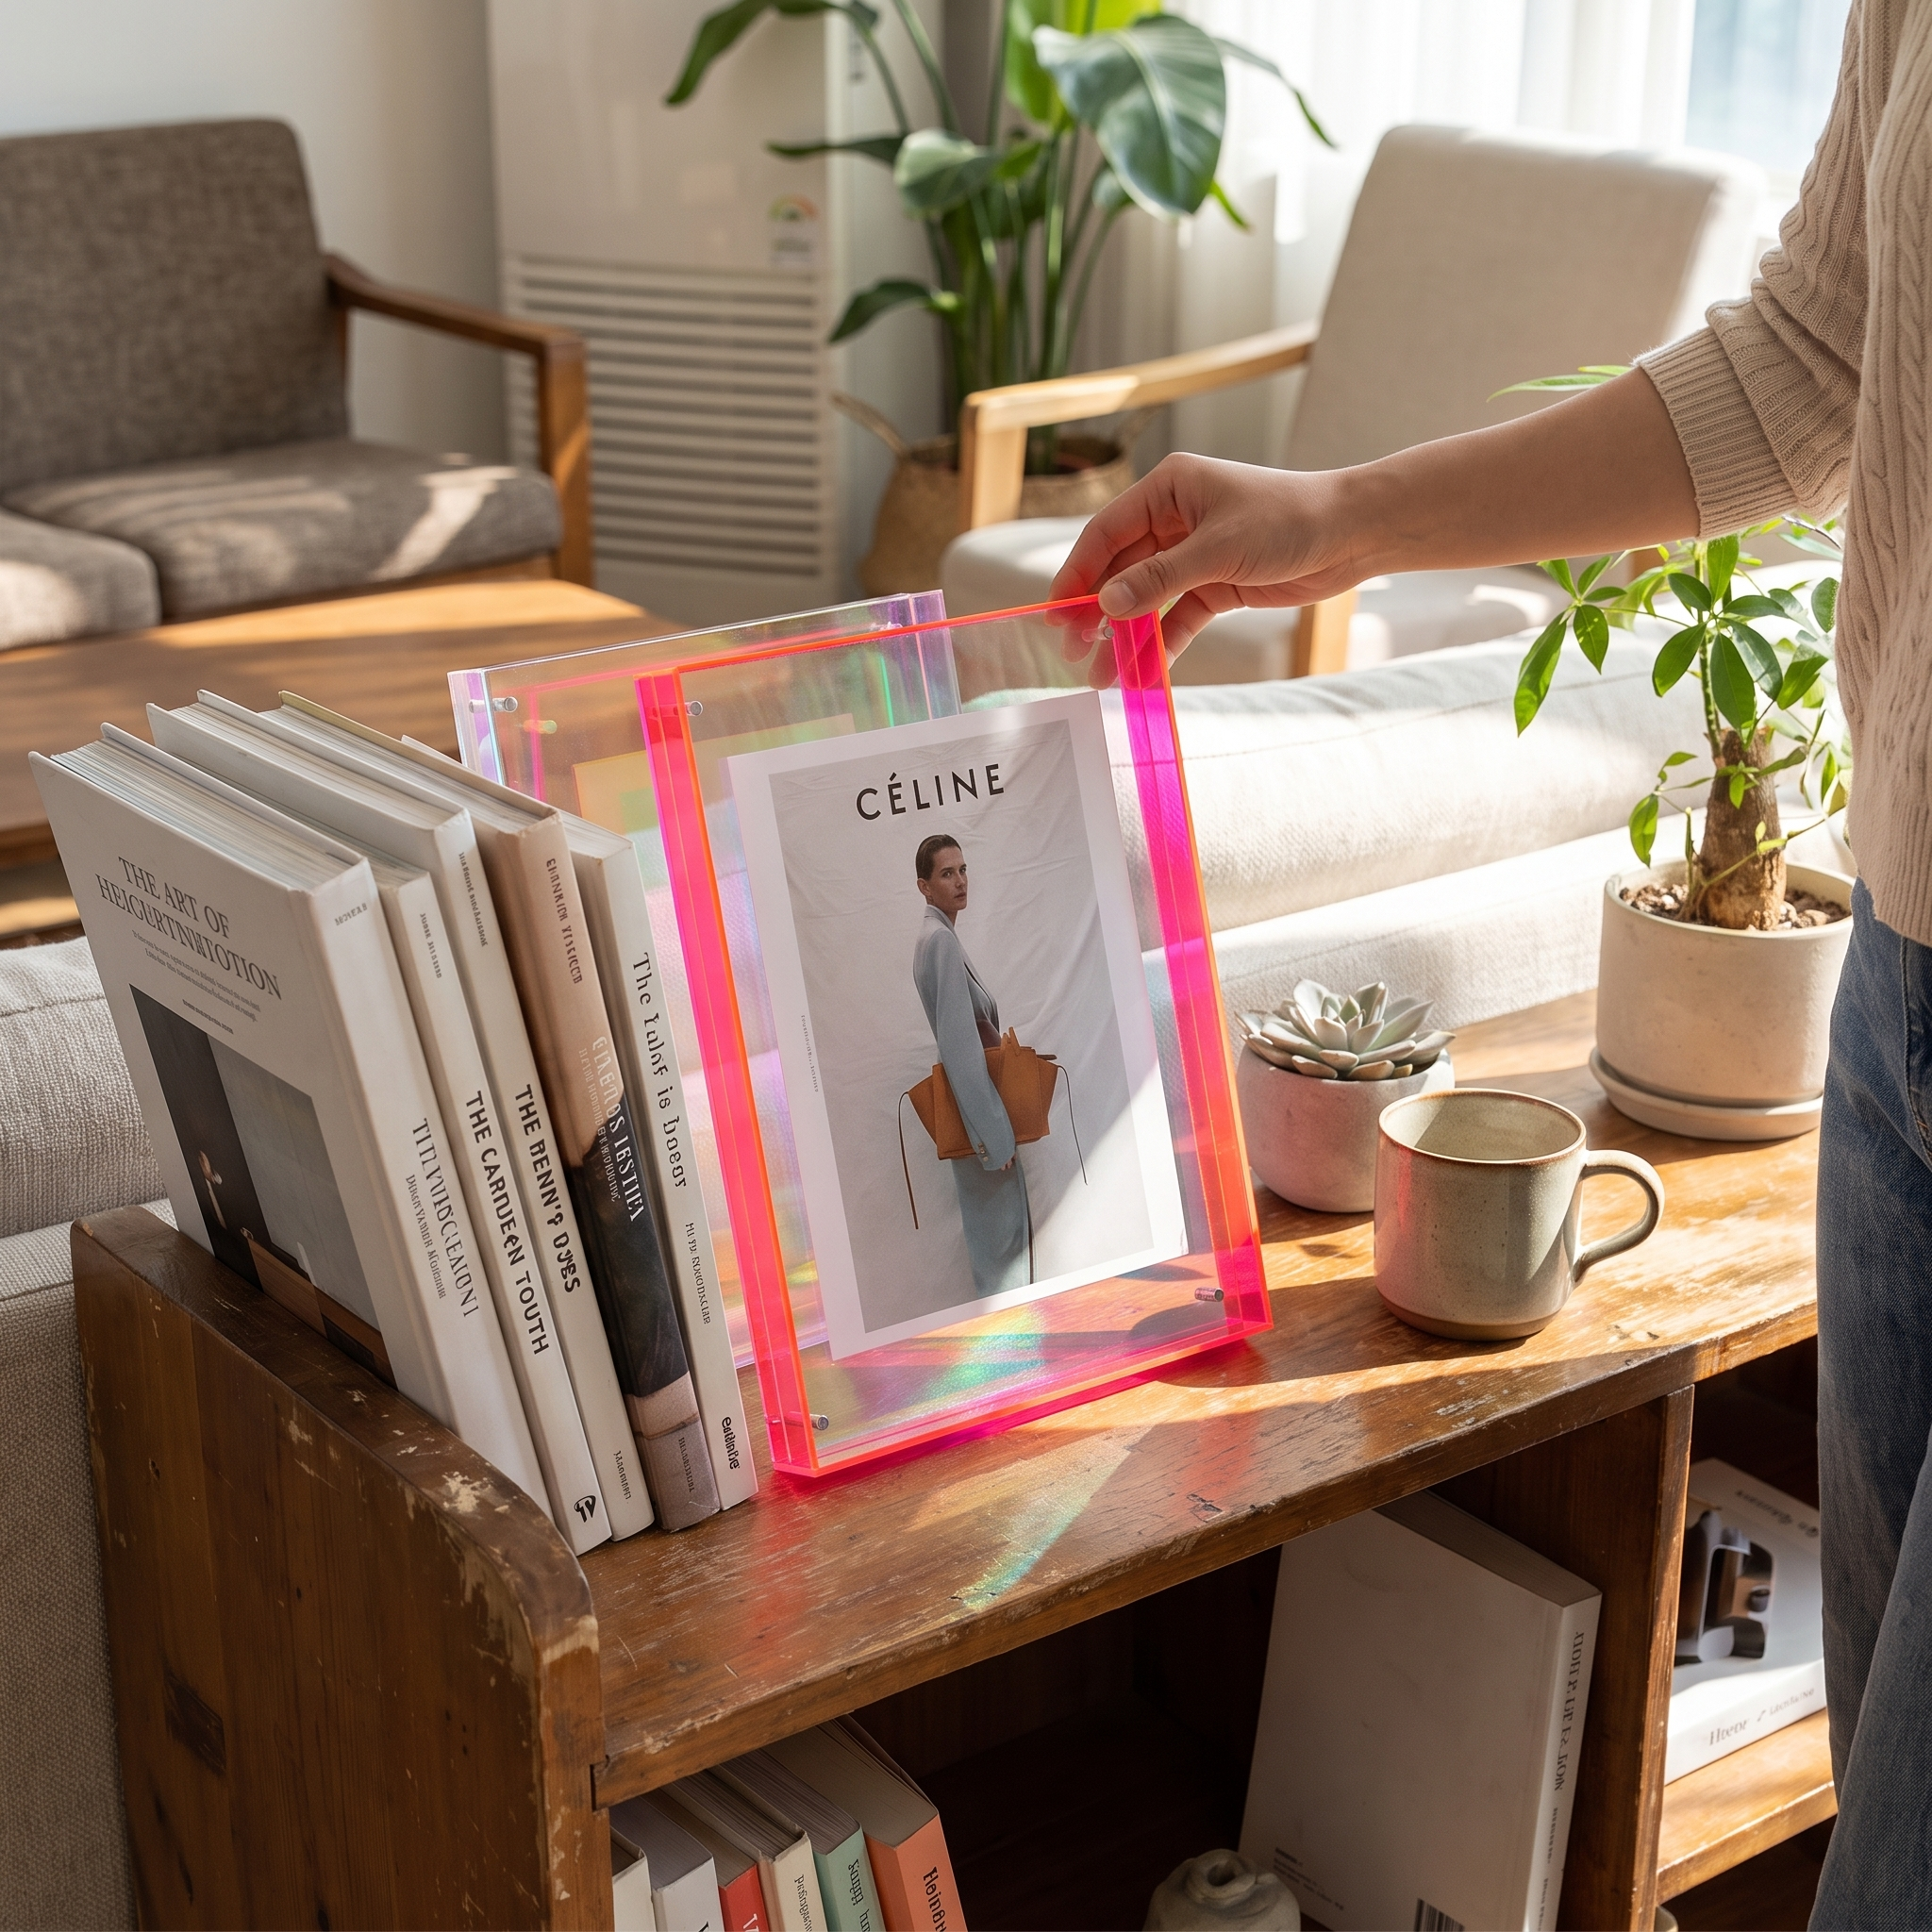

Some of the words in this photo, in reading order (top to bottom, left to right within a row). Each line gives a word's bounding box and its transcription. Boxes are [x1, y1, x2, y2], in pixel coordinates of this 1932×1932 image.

[856, 763, 1005, 821] CÉLINE
[118, 856, 160, 900] THE
[164, 882, 199, 932] ART
[204, 905, 229, 940] OF
[632, 952, 651, 1005] The
[658, 1087, 672, 1109] is
[514, 1084, 542, 1136] THE
[466, 1091, 497, 1143] THE
[514, 1271, 550, 1356] TOUTH
